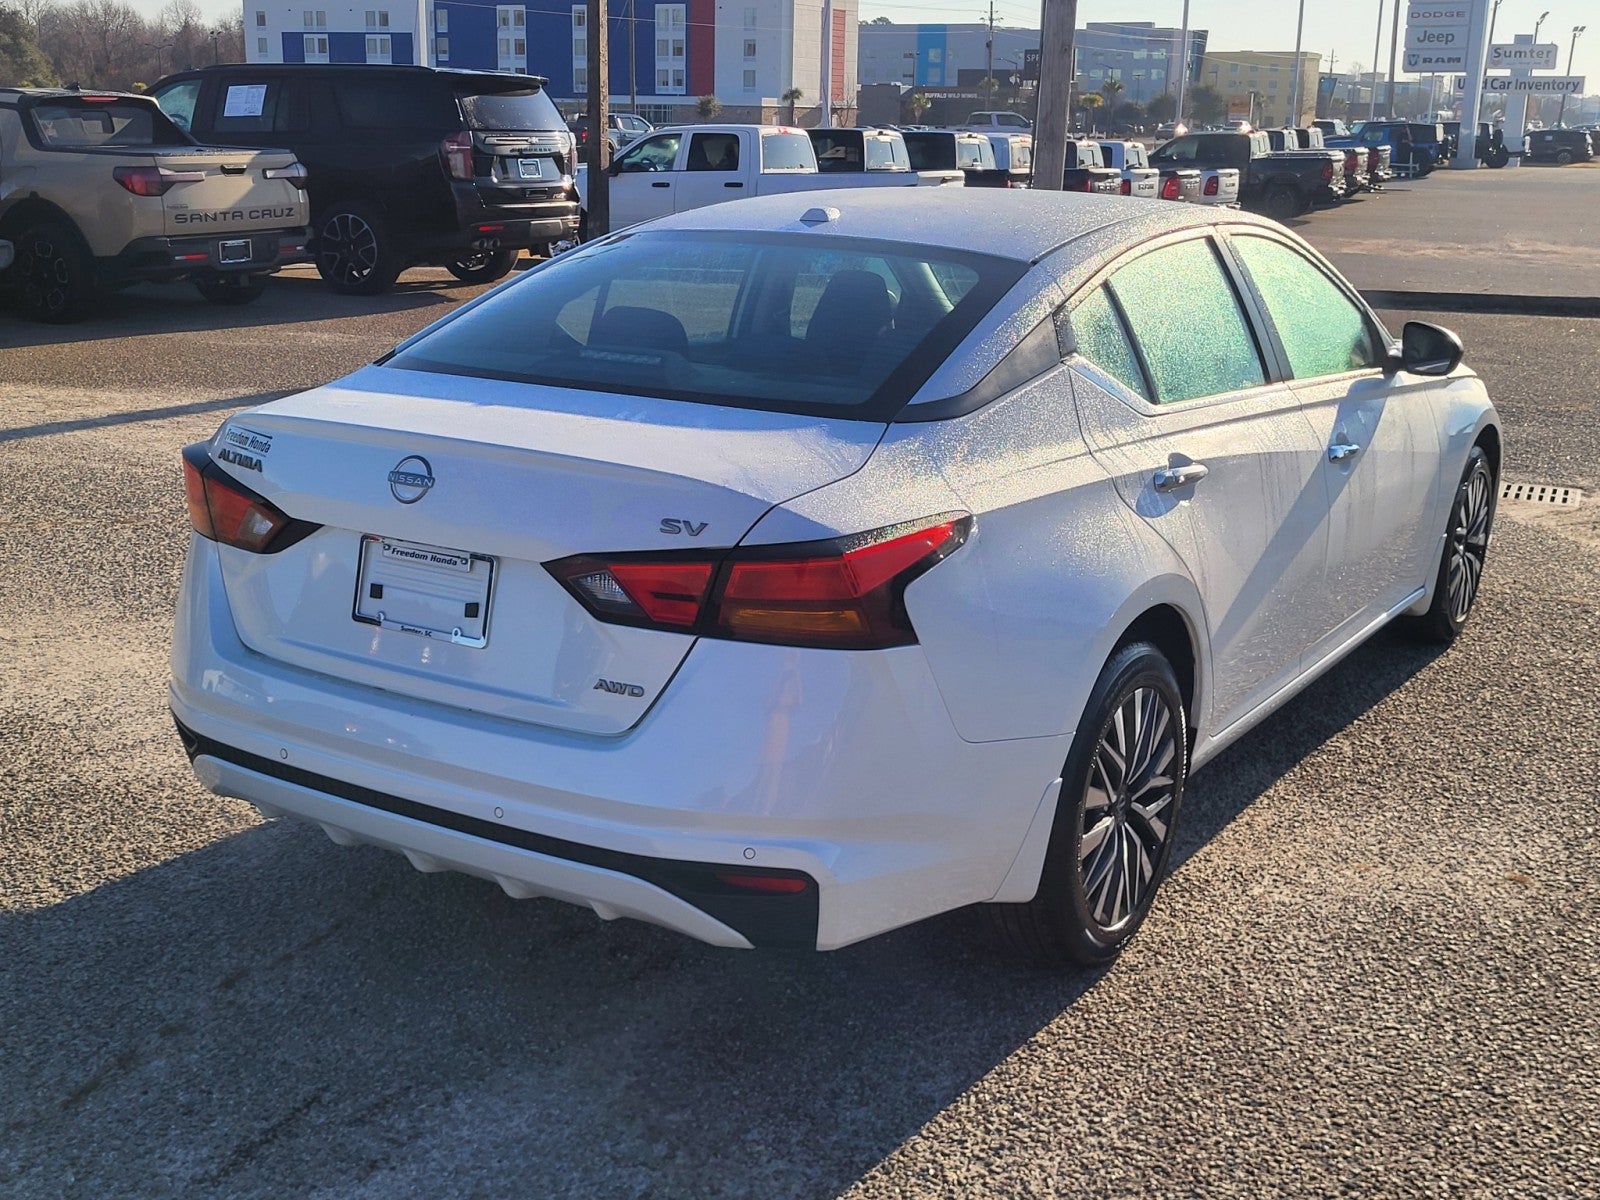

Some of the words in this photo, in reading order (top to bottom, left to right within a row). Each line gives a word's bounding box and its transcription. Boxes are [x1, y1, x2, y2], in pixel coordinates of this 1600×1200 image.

[1410, 11, 1466, 19] DODGE
[1417, 30, 1455, 45] Jeep
[1422, 56, 1461, 64] RAM
[1493, 47, 1552, 59] Sumter
[1490, 78, 1512, 91] Car
[1514, 78, 1580, 94] Inventory
[174, 210, 243, 224] SANTA
[249, 207, 295, 220] CRUZ
[225, 428, 250, 446] Freedom
[248, 435, 272, 454] Honda
[218, 448, 263, 473] ALTIMA
[389, 472, 434, 488] NISSAN
[660, 518, 709, 537] SV
[391, 547, 429, 561] Freedom
[430, 554, 458, 566] Honda
[400, 625, 424, 635] Sumter,
[424, 629, 433, 637] SC
[593, 678, 645, 697] AWD
